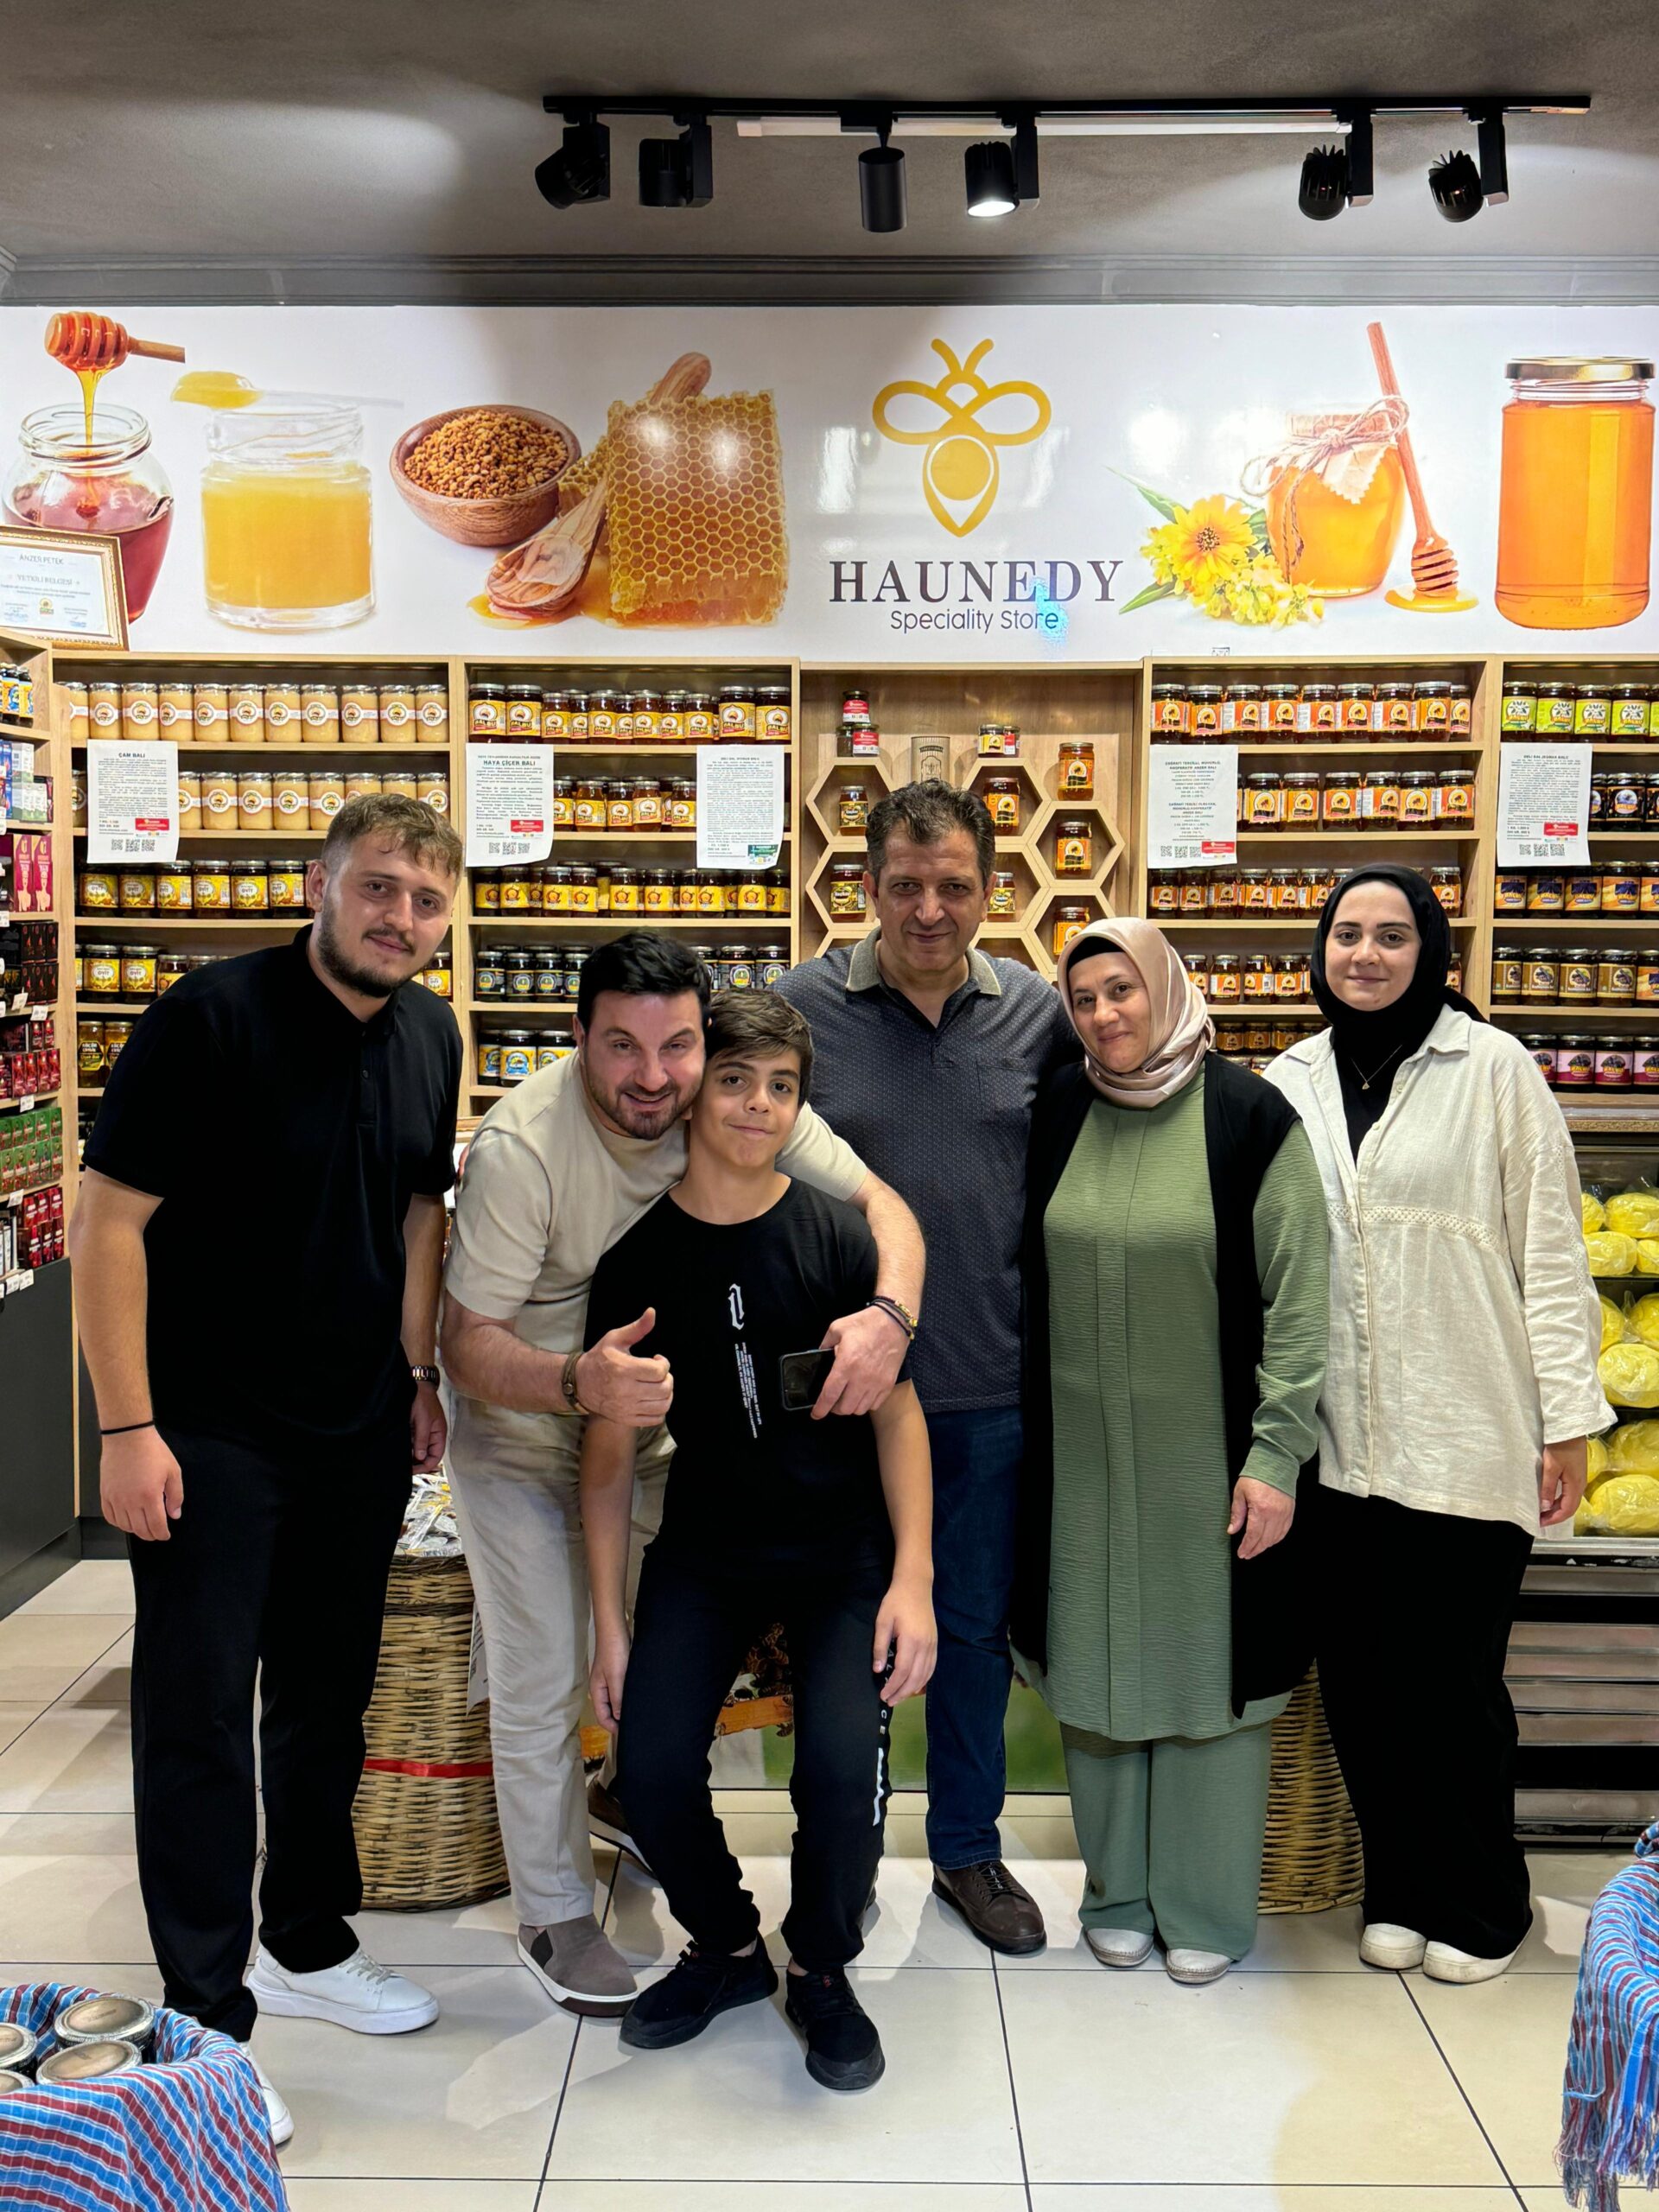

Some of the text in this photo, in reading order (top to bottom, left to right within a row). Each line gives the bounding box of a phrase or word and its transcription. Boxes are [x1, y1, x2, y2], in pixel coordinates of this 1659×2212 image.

[19, 553, 42, 563] ANZER
[830, 560, 1123, 602] HAUNEDY
[890, 609, 1058, 634] Speciality Store
